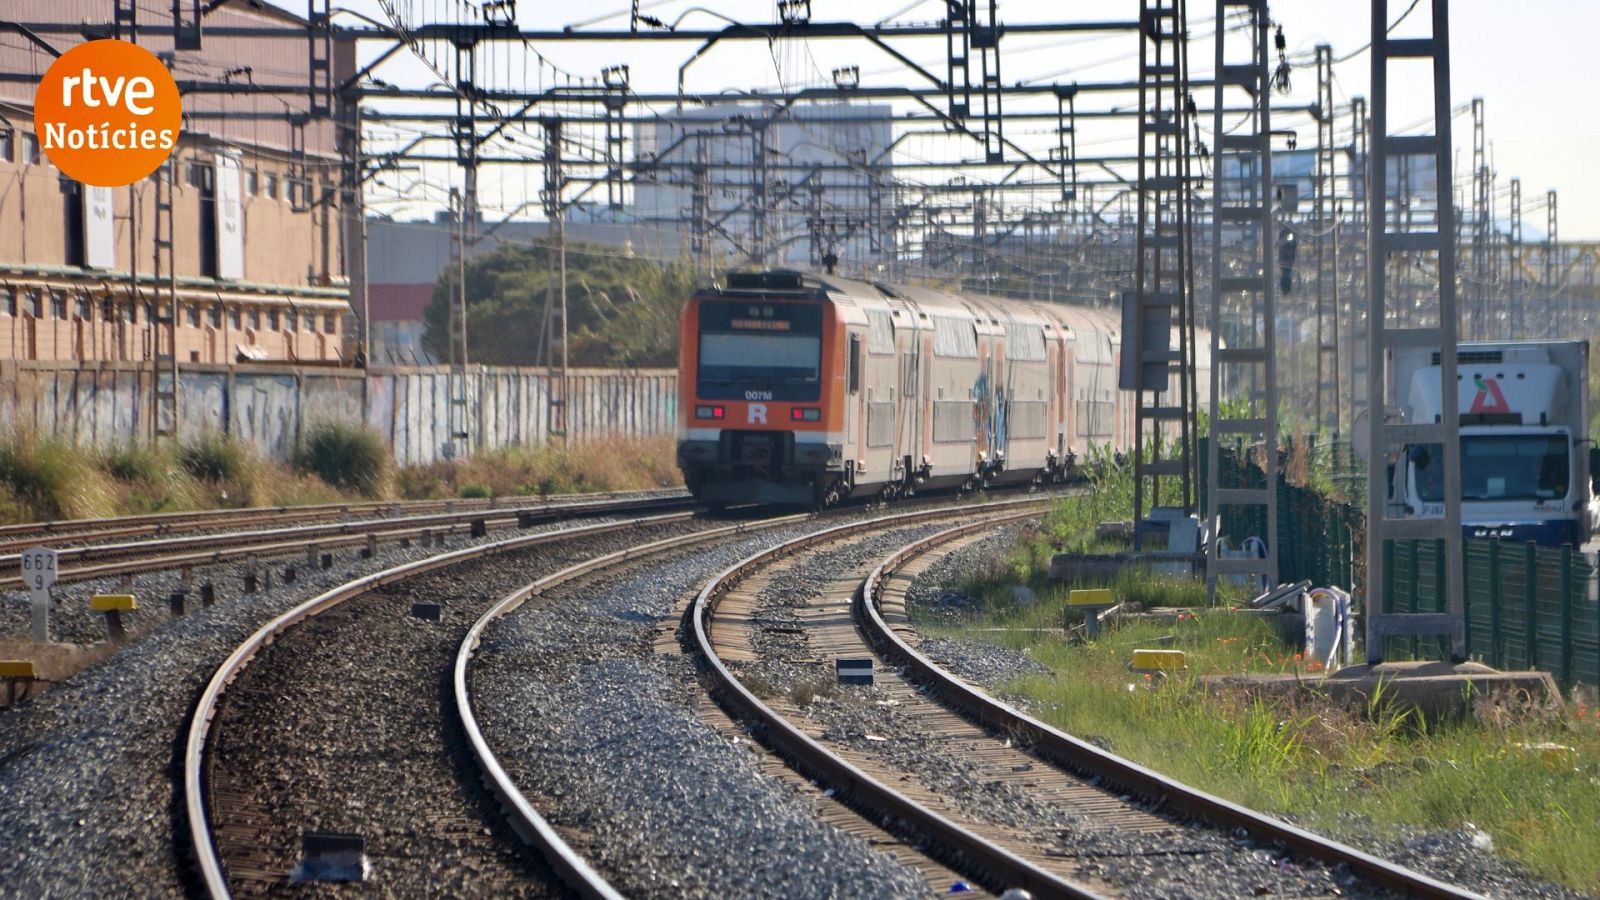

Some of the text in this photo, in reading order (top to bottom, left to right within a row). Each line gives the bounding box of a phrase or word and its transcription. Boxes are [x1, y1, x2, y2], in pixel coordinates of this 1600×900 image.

[744, 390, 773, 400] 007M
[748, 403, 767, 424] R
[24, 554, 53, 570] 662
[35, 574, 43, 590] 9
